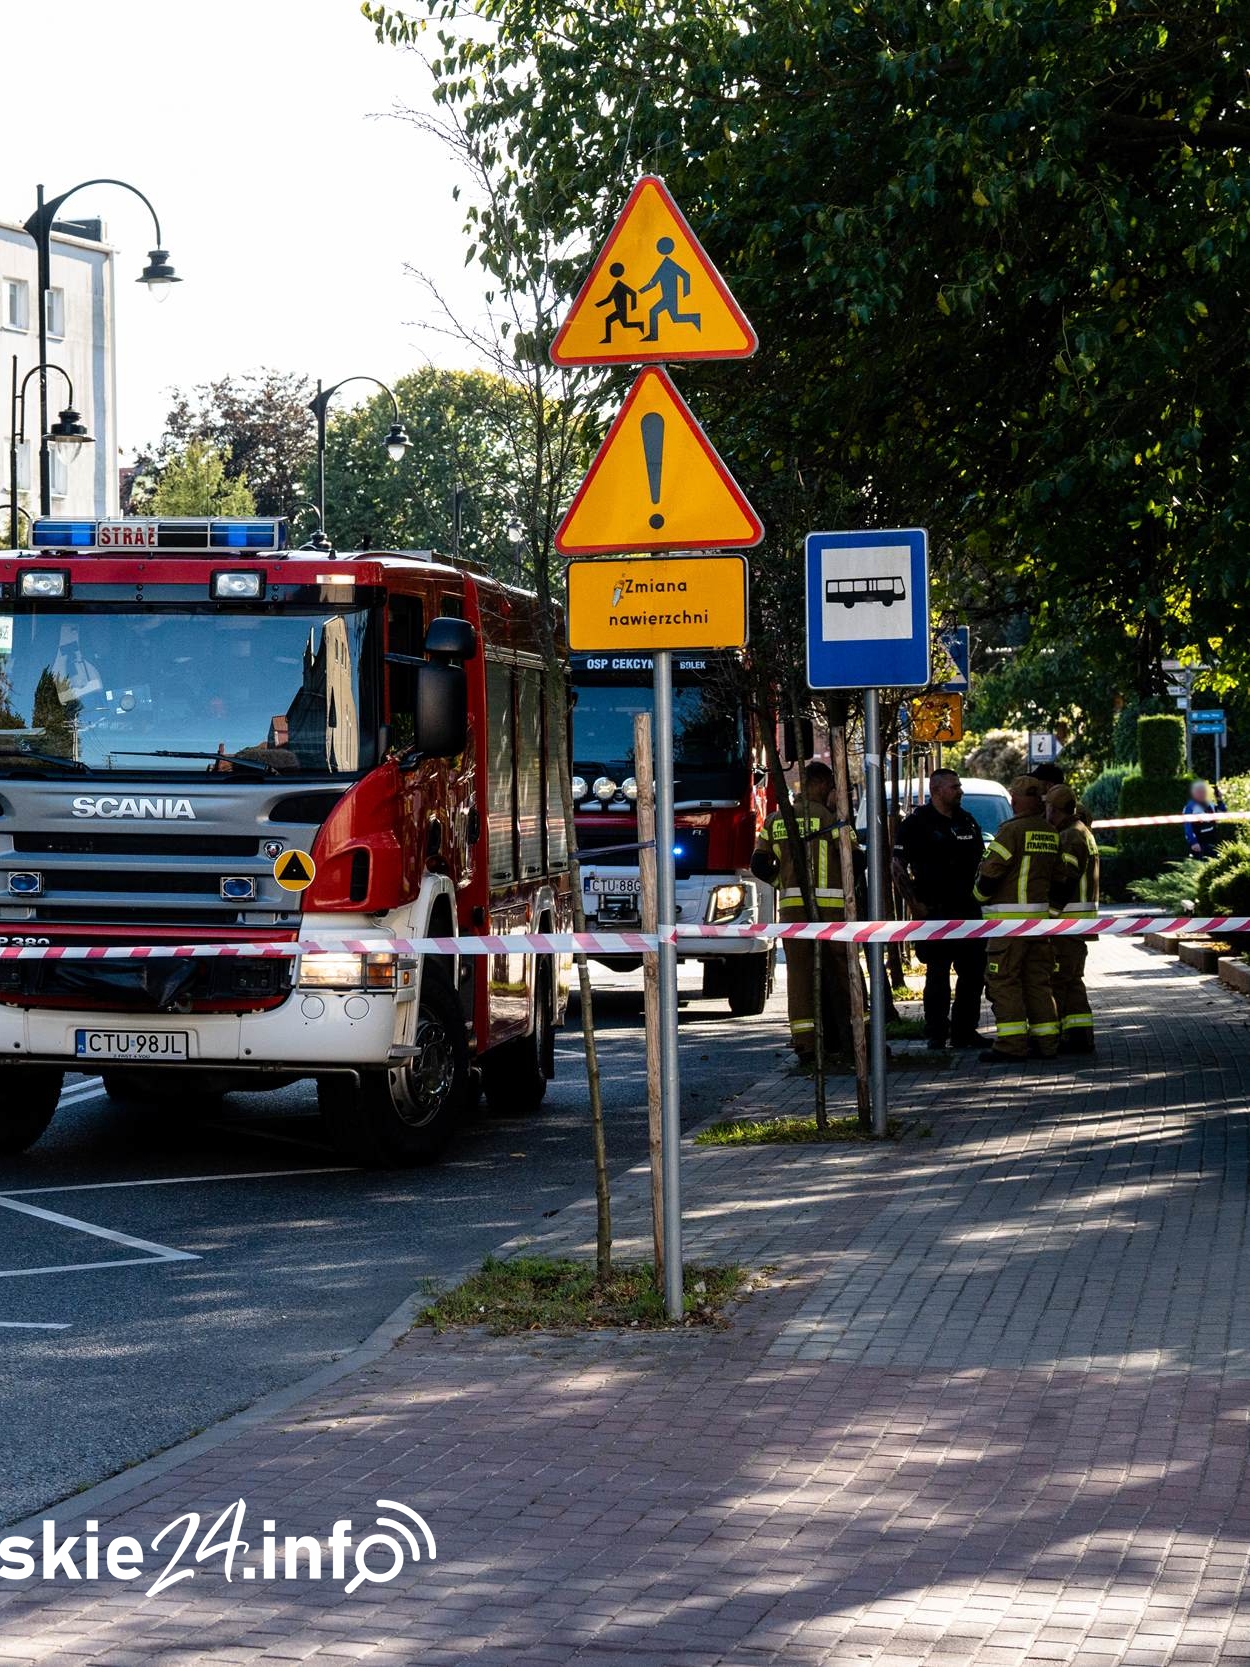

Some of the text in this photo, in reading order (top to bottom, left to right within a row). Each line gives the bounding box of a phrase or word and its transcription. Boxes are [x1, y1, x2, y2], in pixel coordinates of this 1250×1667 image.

[624, 578, 687, 594] Zmiana
[609, 609, 708, 626] nawierzchni
[587, 659, 608, 670] OSP
[71, 797, 197, 819] SCANIA
[592, 879, 641, 892] CTU 88G
[89, 1034, 182, 1053] CTU 98JL
